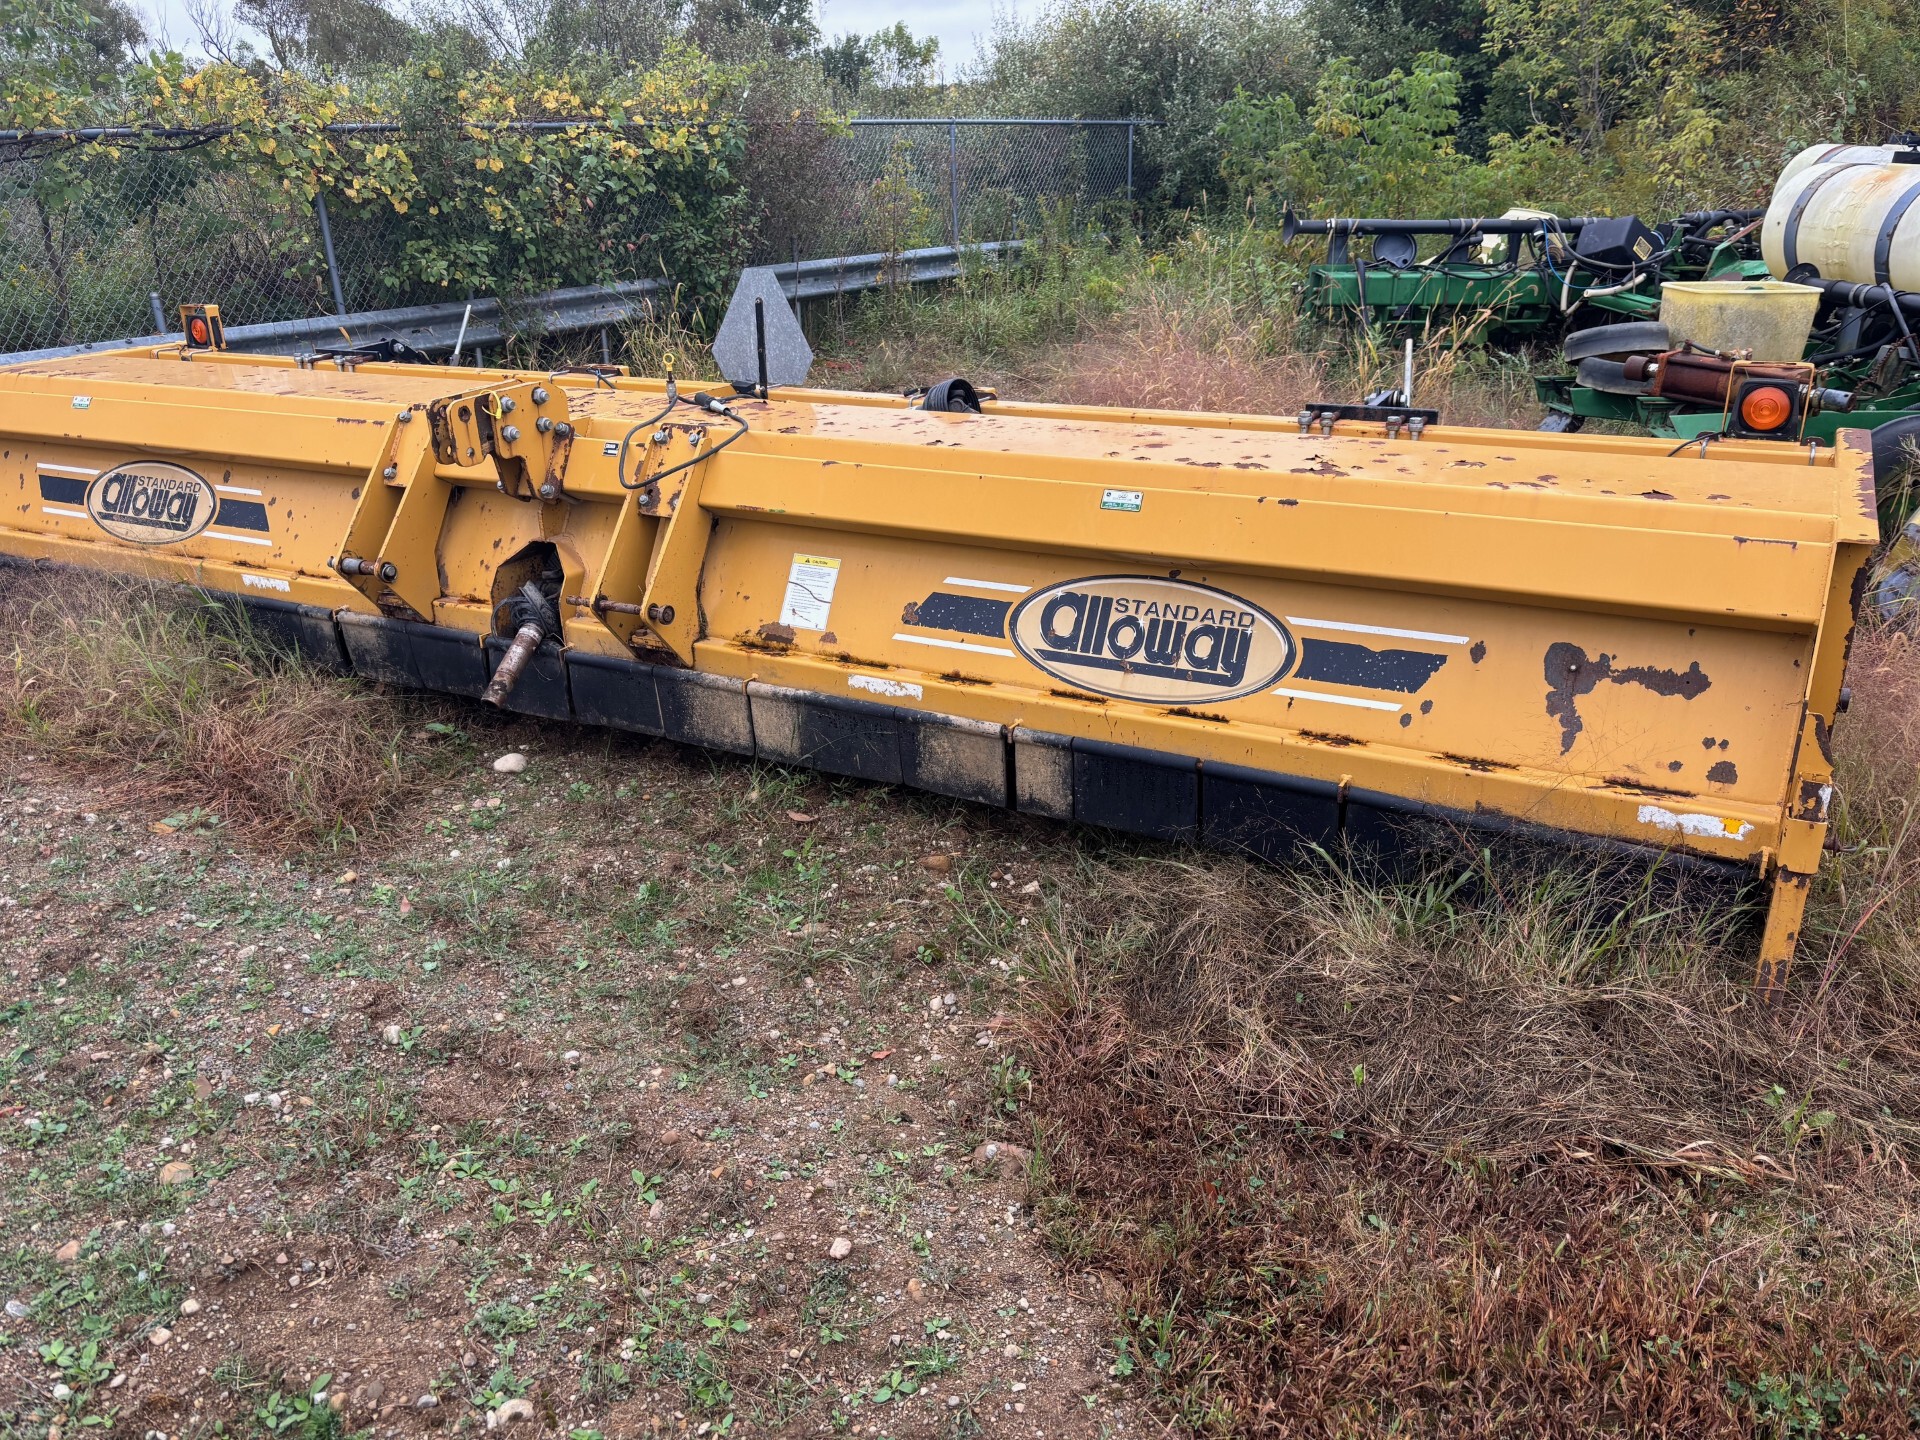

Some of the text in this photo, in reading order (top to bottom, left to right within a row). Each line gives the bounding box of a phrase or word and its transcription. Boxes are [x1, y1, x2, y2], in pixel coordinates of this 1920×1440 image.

[97, 473, 199, 532] alloway
[138, 476, 201, 493] STANDARD
[1114, 597, 1255, 629] STANDARD
[1034, 591, 1253, 687] alloway
